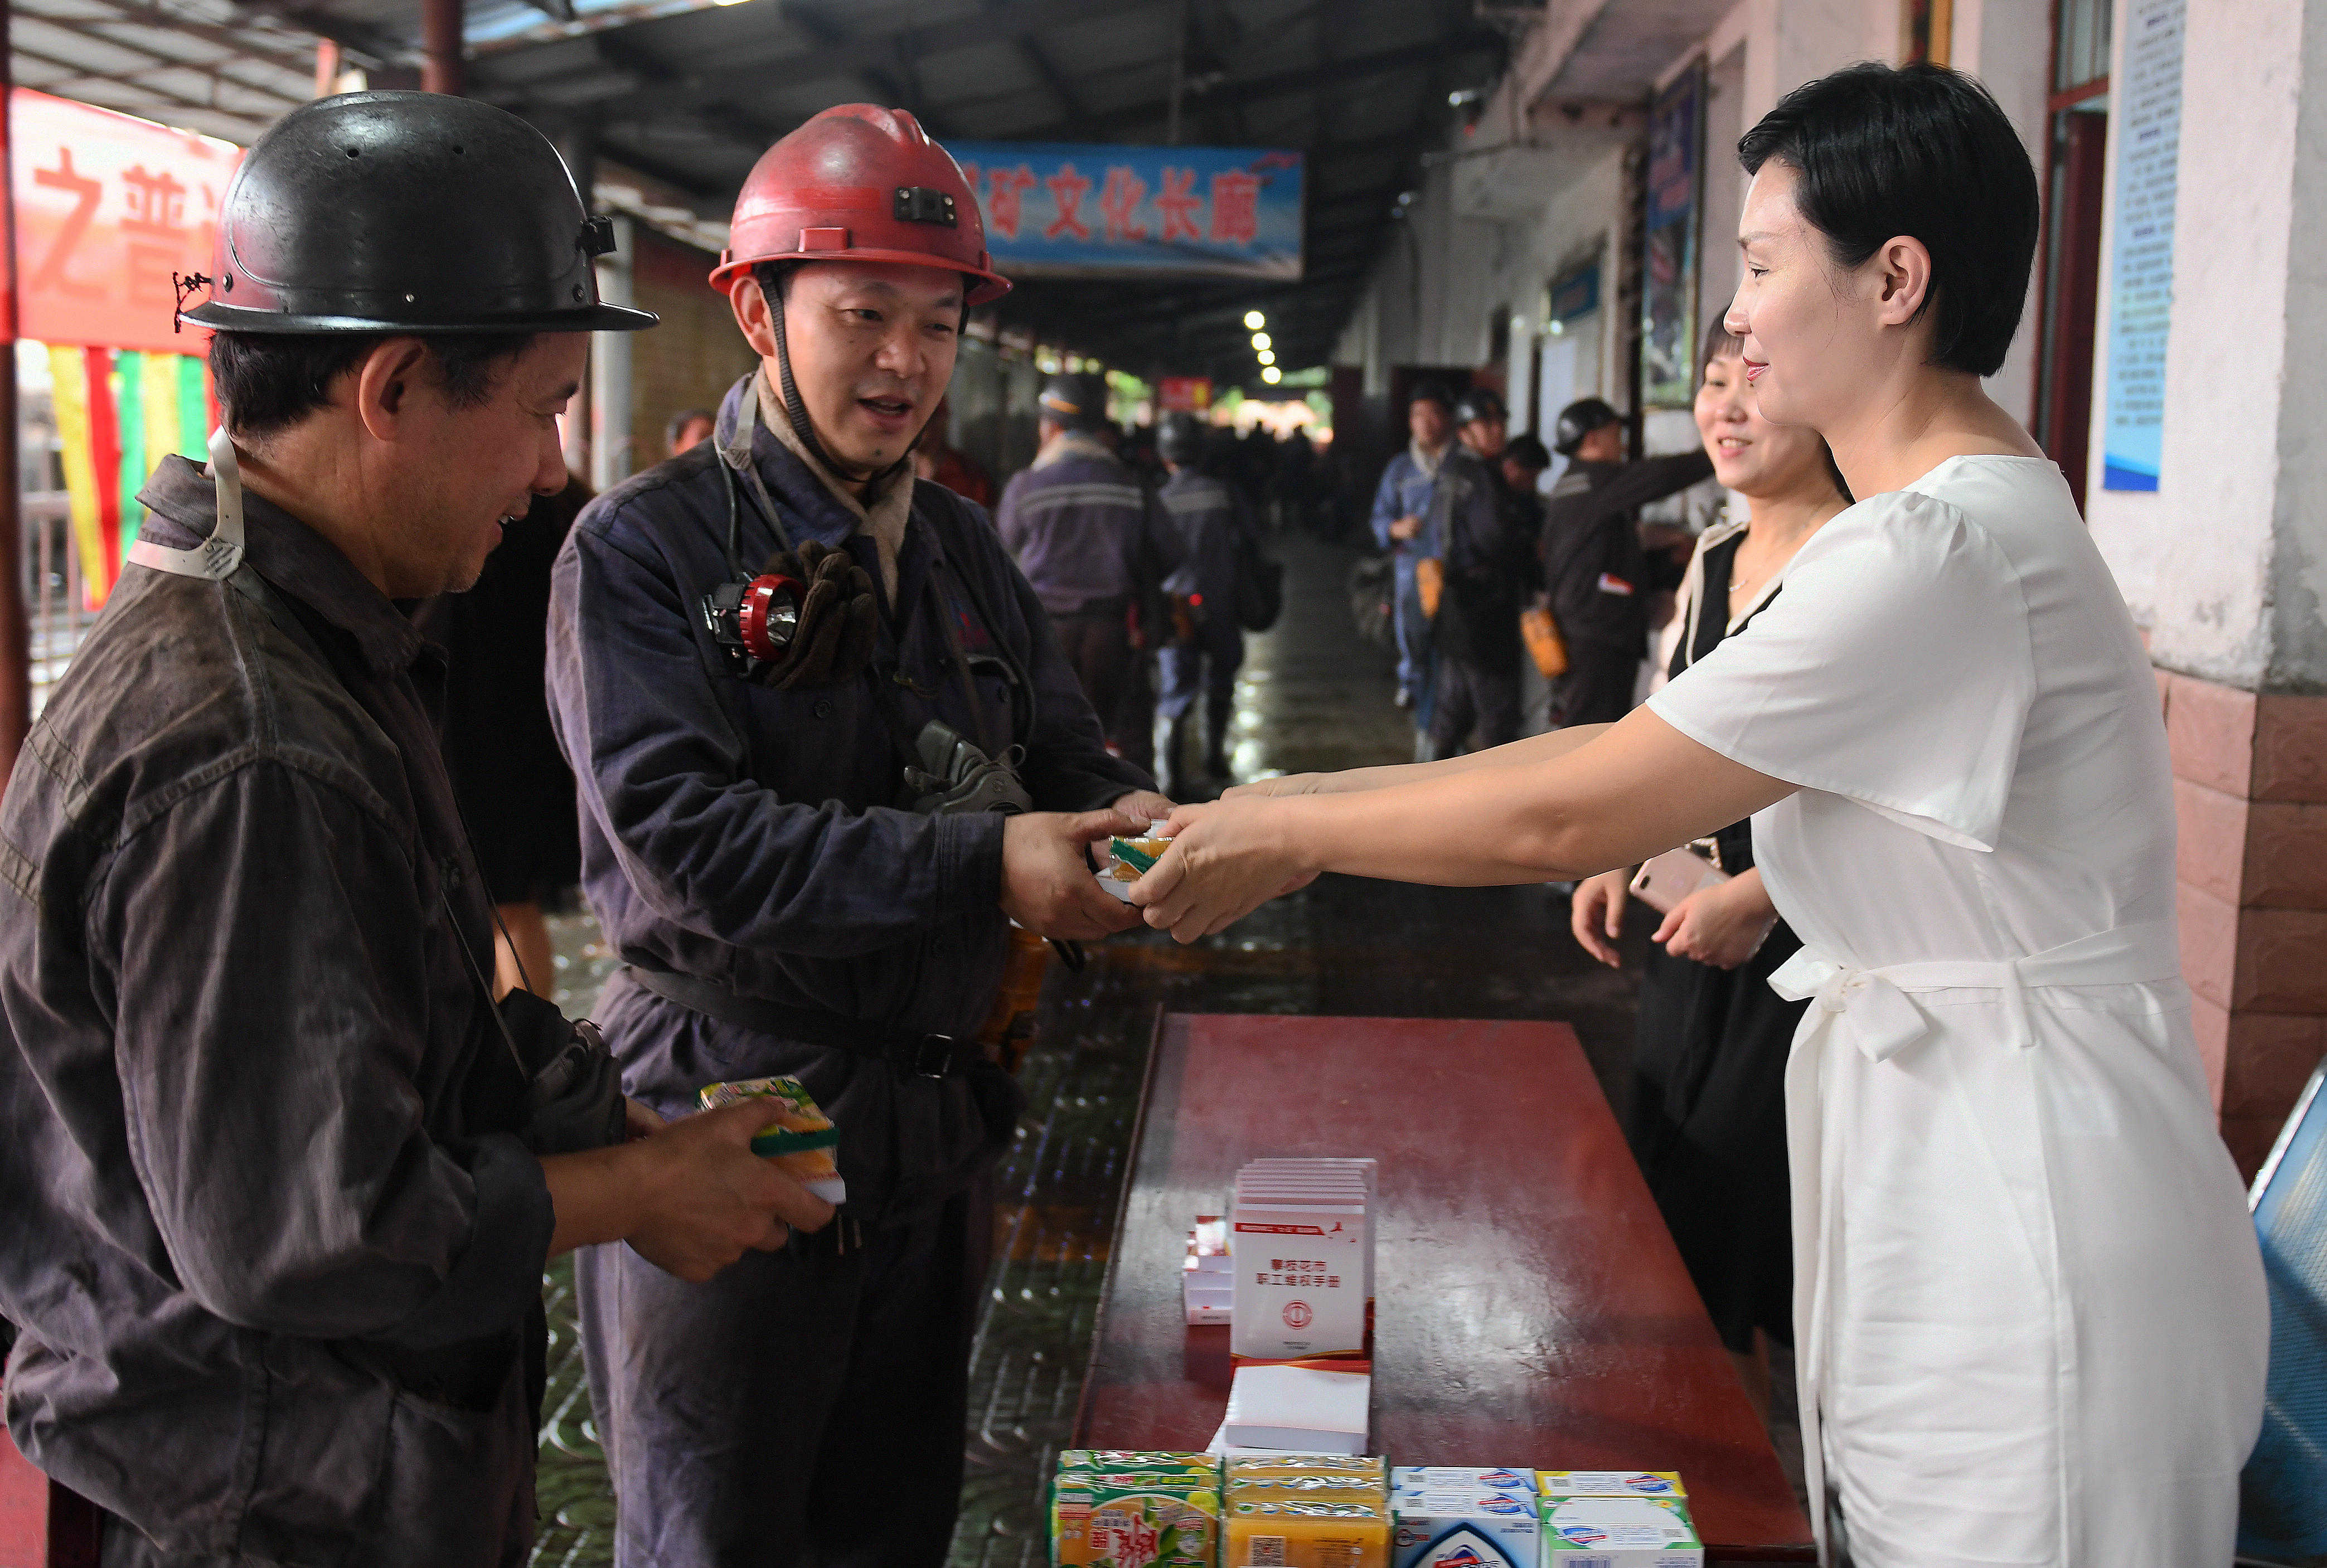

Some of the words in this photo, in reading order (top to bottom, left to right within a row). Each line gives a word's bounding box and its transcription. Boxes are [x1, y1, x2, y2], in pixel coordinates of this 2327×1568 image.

[32, 146, 215, 310] 之普
[965, 163, 1260, 246] 矿文化长廊
